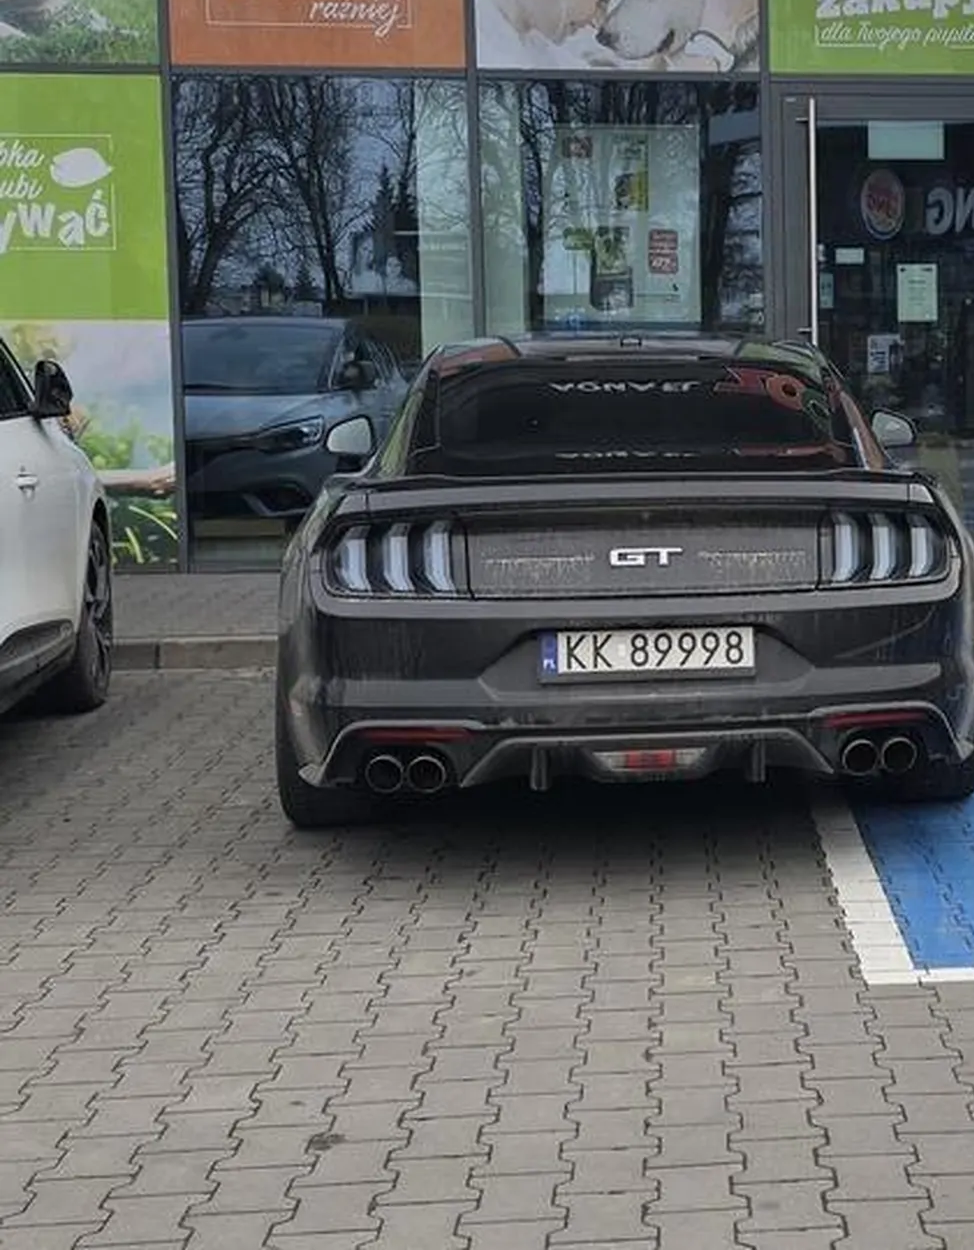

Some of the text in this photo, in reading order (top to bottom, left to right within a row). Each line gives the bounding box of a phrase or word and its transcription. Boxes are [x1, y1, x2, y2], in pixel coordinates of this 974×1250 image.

[609, 547, 683, 566] GT
[566, 630, 744, 669] KK 89998
